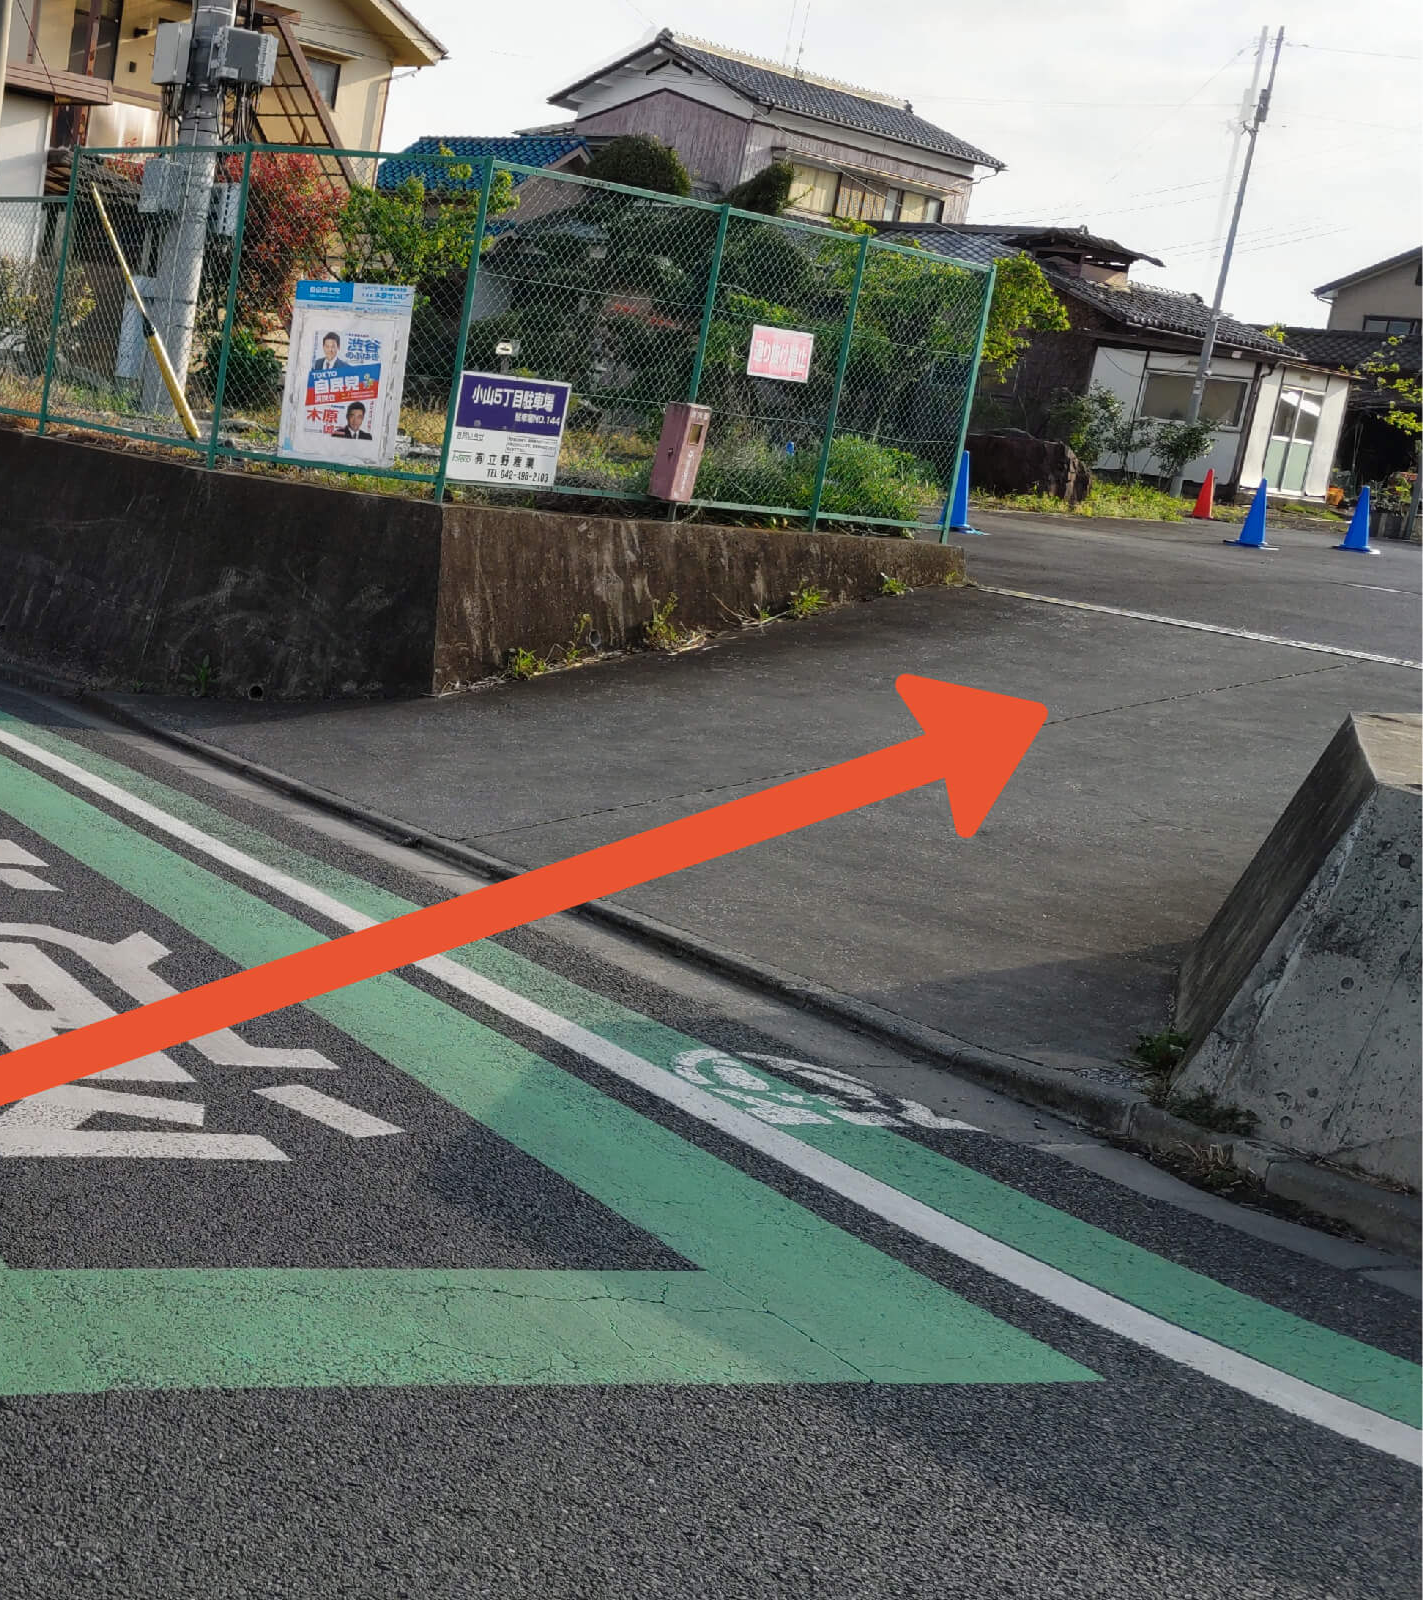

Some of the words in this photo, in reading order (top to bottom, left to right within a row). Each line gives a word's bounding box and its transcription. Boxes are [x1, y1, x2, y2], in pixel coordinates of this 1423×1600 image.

[347, 337, 381, 352] 渋谷
[311, 370, 338, 379] TOKYO
[314, 375, 360, 394] 自民党
[472, 383, 556, 412] 小山5丁目駐車場
[306, 406, 339, 424] 木原
